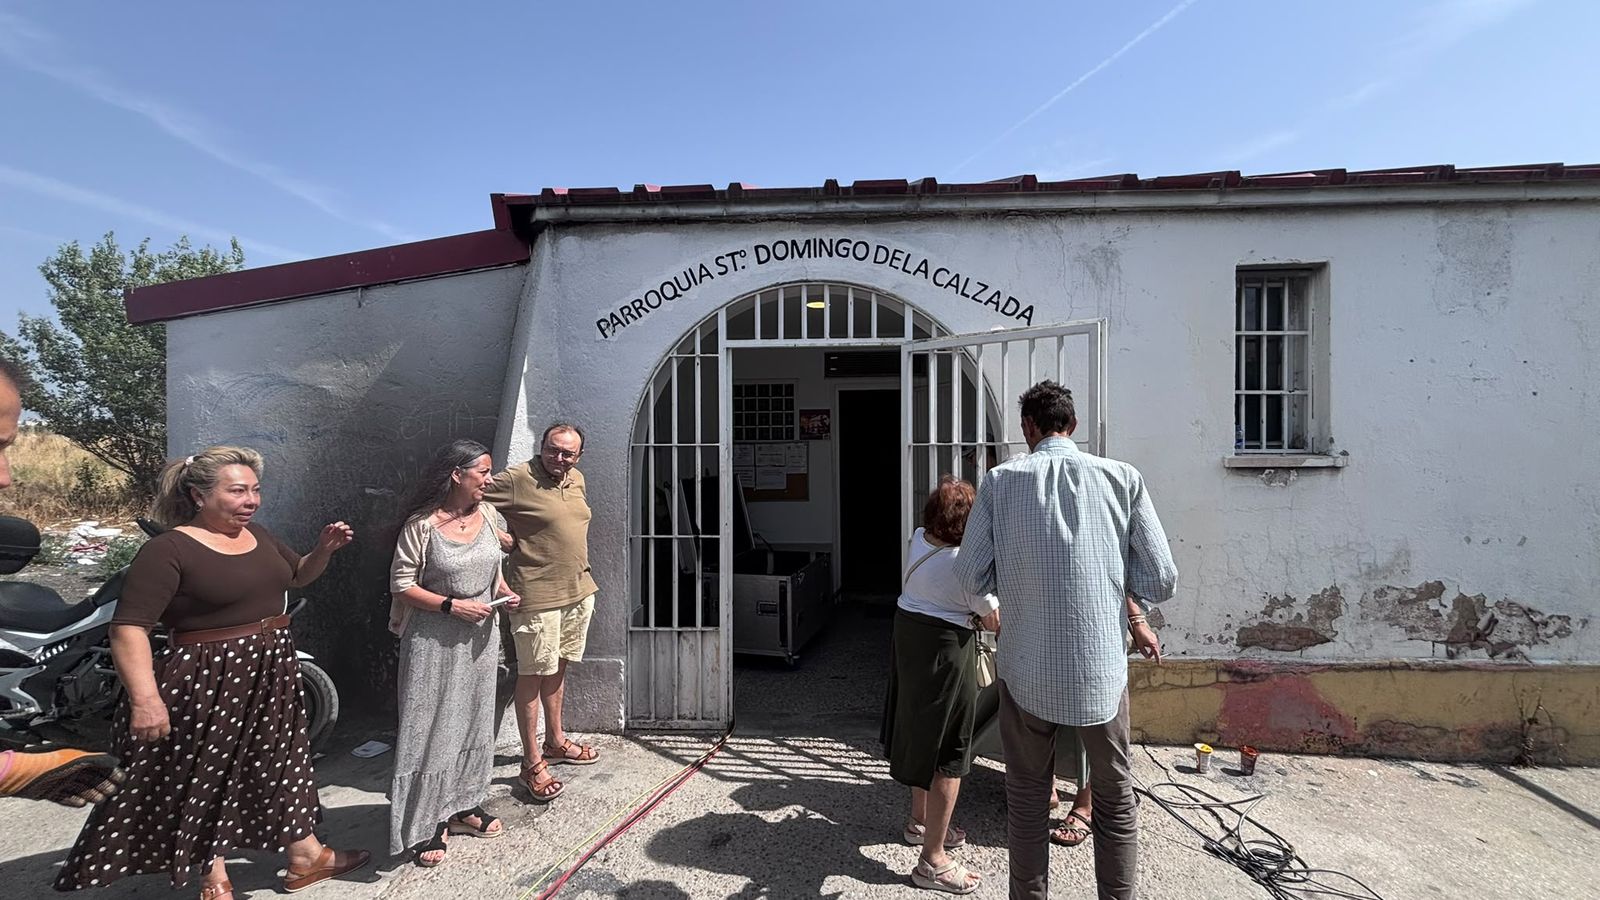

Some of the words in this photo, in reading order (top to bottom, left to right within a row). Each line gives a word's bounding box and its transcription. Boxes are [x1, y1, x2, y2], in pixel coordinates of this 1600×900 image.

[595, 263, 715, 339] PARROQUIA
[753, 237, 870, 265] DOMINGO
[932, 267, 1035, 326] CALZADA
